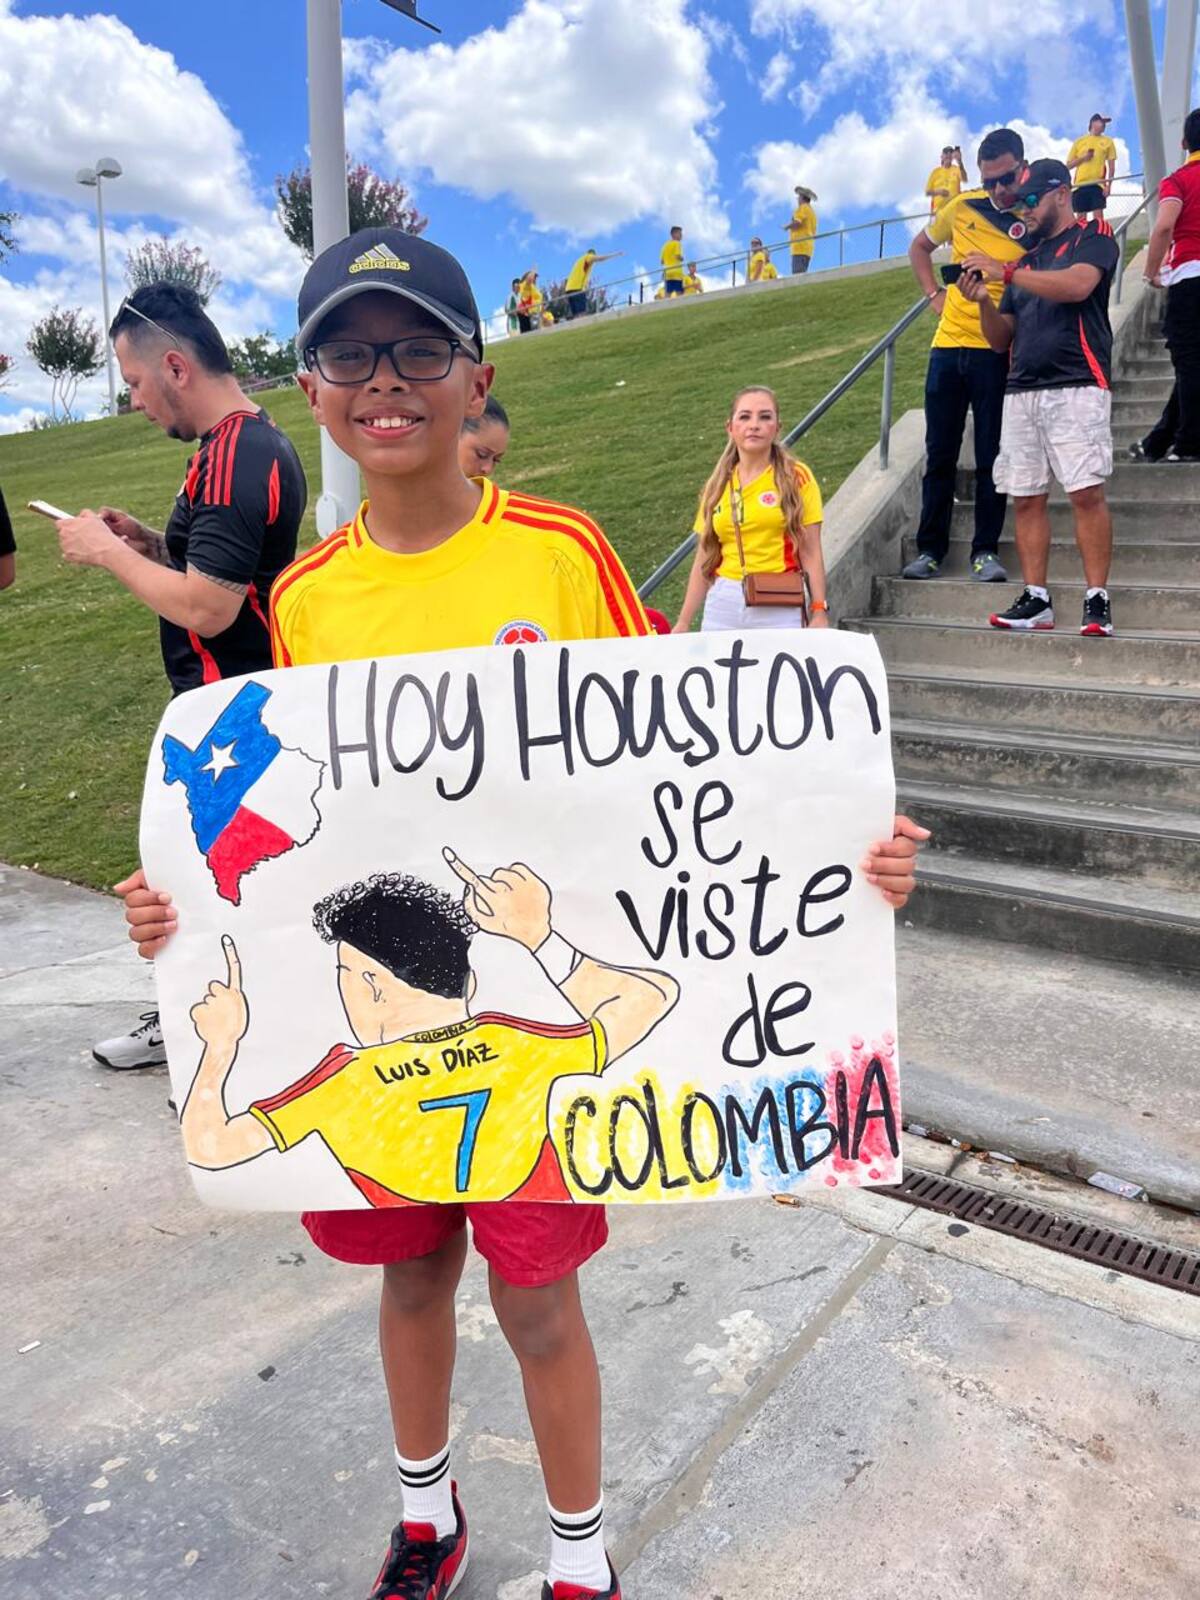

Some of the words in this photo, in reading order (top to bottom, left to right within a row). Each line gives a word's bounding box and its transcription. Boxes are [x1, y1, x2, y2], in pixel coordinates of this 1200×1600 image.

[349, 261, 410, 274] adidas
[513, 639, 881, 781] Houston
[641, 781, 743, 868] se
[615, 855, 853, 961] viste
[374, 1058, 430, 1085] LUIS
[441, 1039, 499, 1073] DÍAZ
[722, 972, 816, 1068] de
[418, 1087, 493, 1193] 7
[565, 1057, 900, 1195] COLOMBIA
